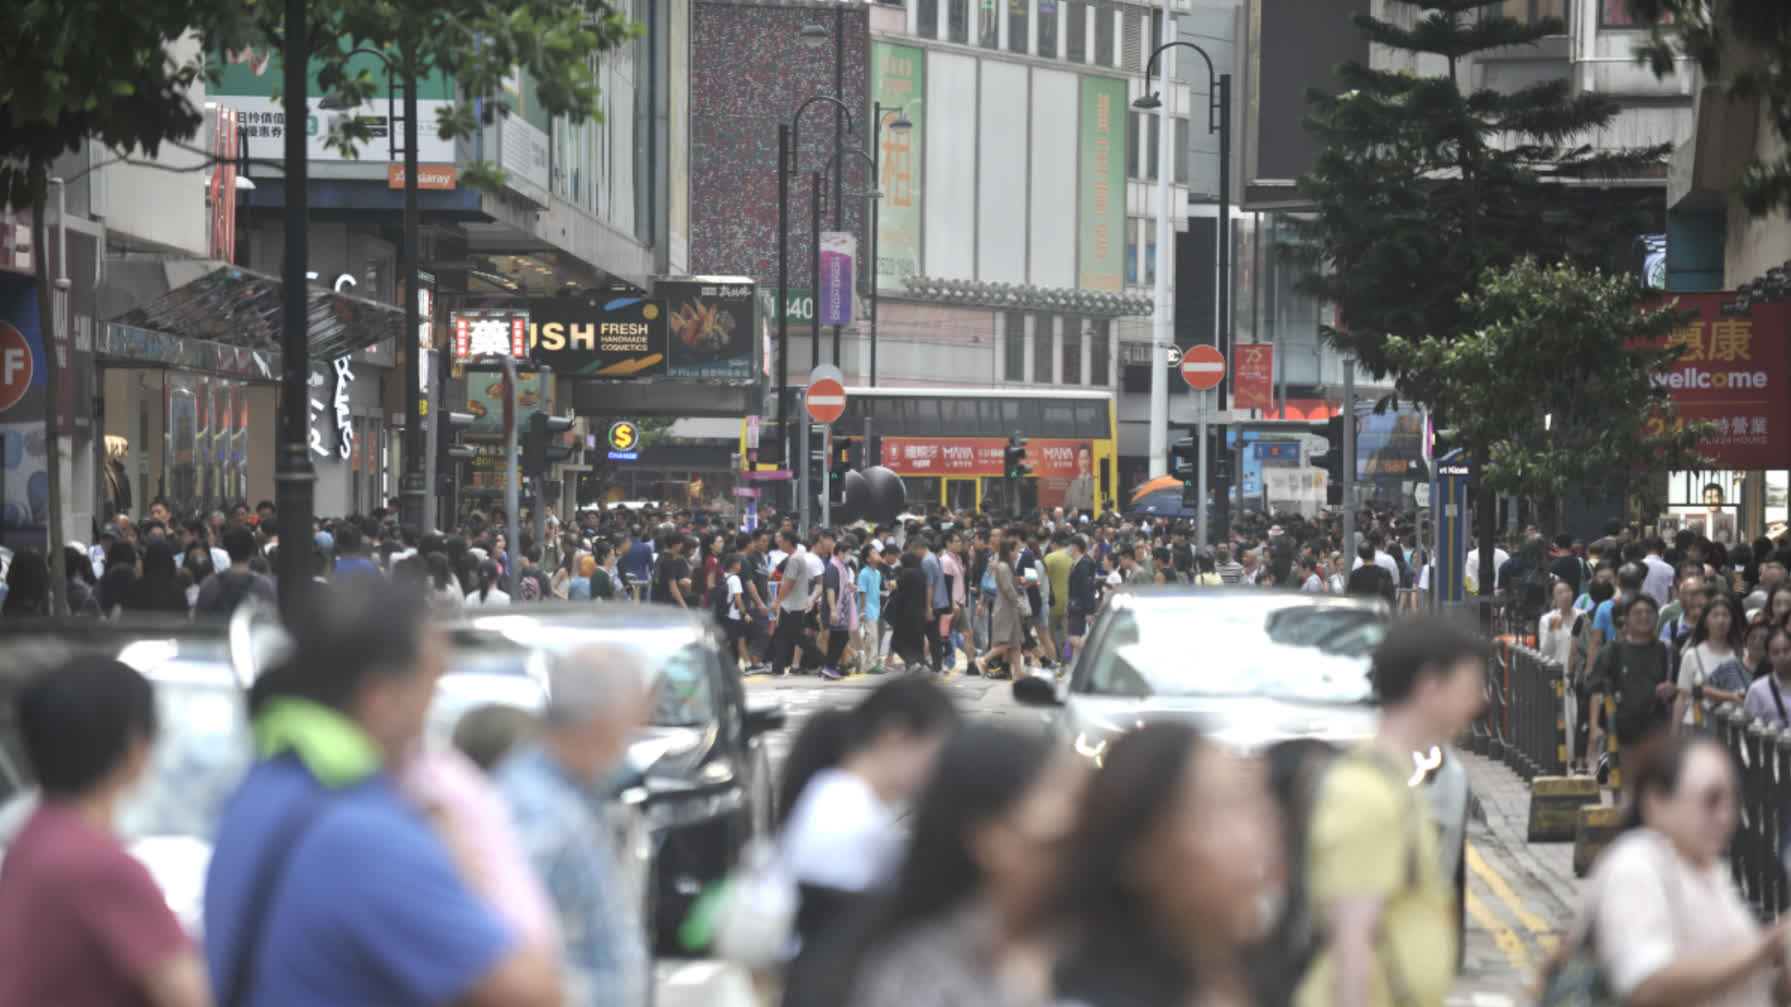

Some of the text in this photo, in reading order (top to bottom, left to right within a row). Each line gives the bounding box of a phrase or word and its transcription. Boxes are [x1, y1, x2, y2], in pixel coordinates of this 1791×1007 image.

[601, 322, 648, 335] FRESH
[601, 335, 648, 344] HANDMADE
[1648, 367, 1767, 389] wellcome
